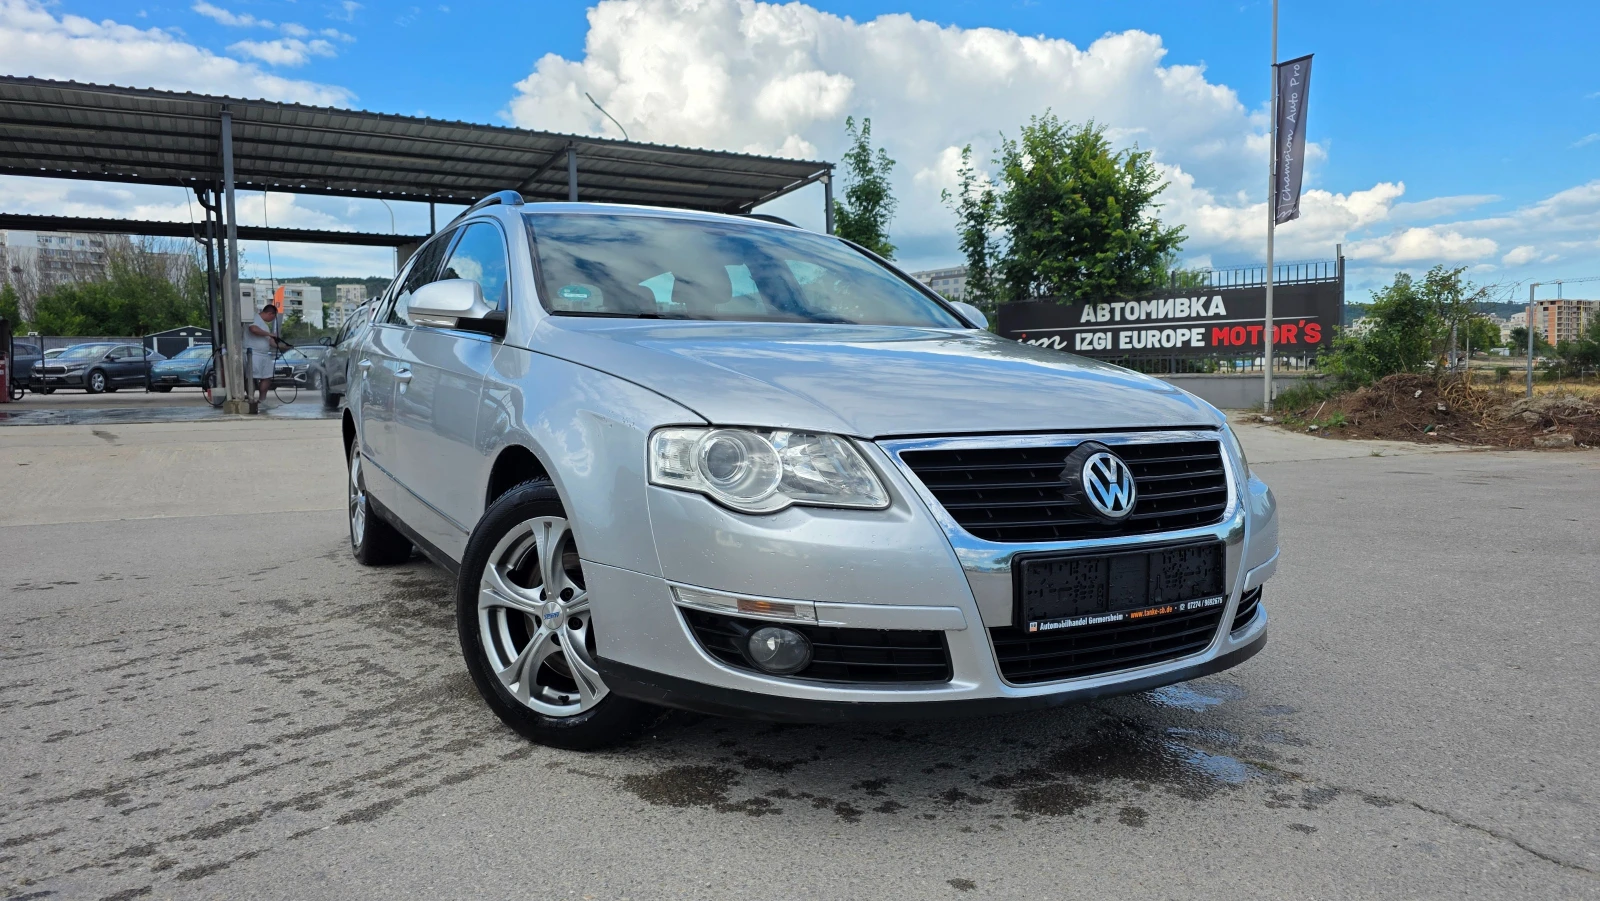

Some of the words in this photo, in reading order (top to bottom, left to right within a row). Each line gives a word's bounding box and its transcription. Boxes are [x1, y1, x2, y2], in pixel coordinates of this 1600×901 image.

[1290, 64, 1300, 87] Pro
[1286, 92, 1298, 123] Auto
[1282, 129, 1293, 201] Champion
[1080, 295, 1227, 324] АВТОМИВКА
[1075, 331, 1112, 351] IZGI
[1119, 327, 1205, 349] EUROPE
[1212, 319, 1322, 346] MOTOR'S
[1086, 455, 1132, 514] VW
